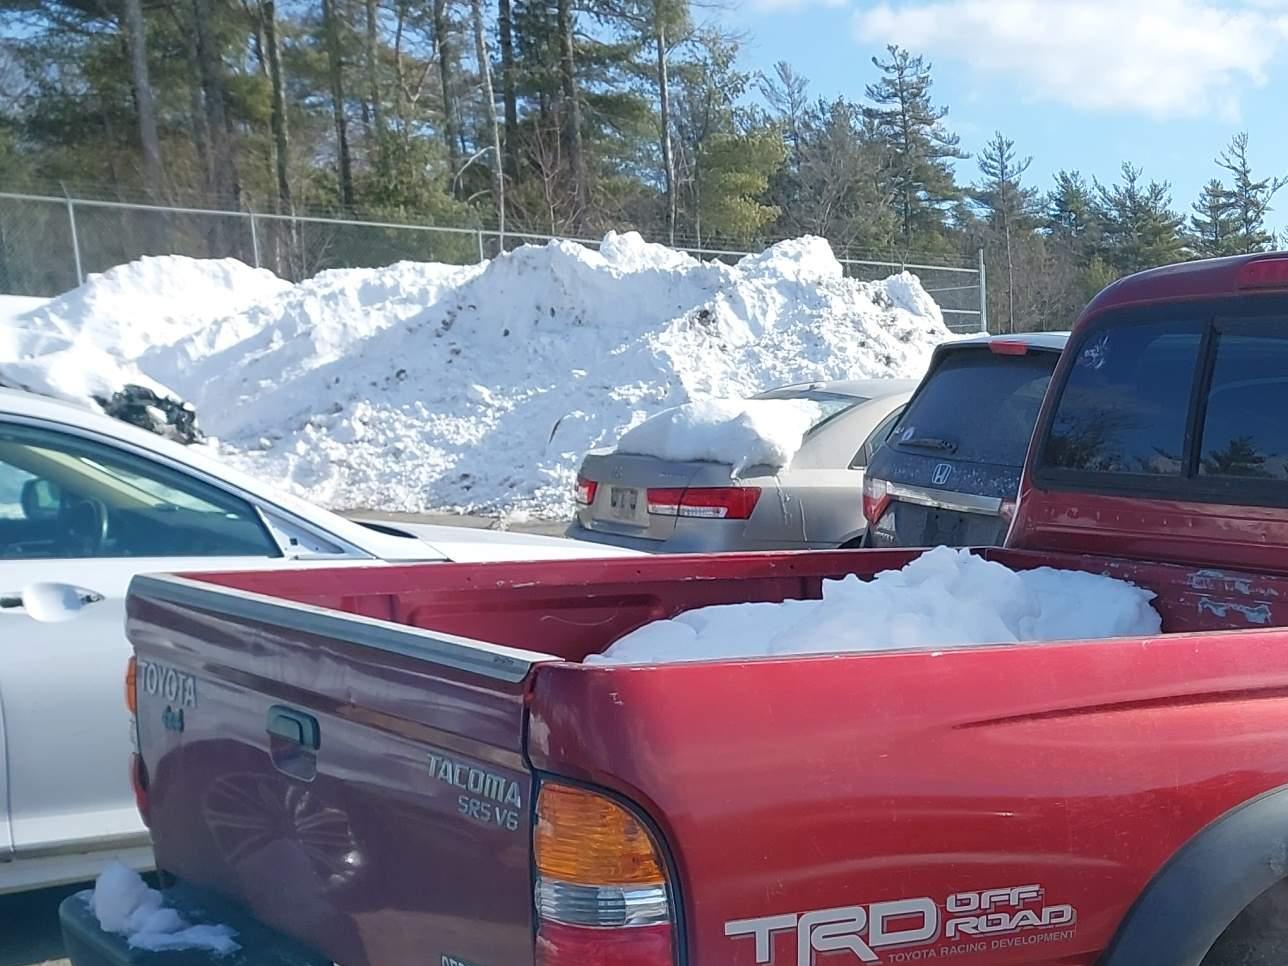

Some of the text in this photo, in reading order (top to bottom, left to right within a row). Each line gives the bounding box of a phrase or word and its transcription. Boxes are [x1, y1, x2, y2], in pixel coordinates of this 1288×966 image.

[139, 661, 198, 710] TOYOTA
[427, 753, 521, 809] TACOMA
[458, 795, 519, 832] SR5 V6
[945, 883, 1043, 914] OFF
[945, 904, 1077, 939] ROAD
[888, 930, 1075, 963] TOYOTA RACING DEVELOPMENT
